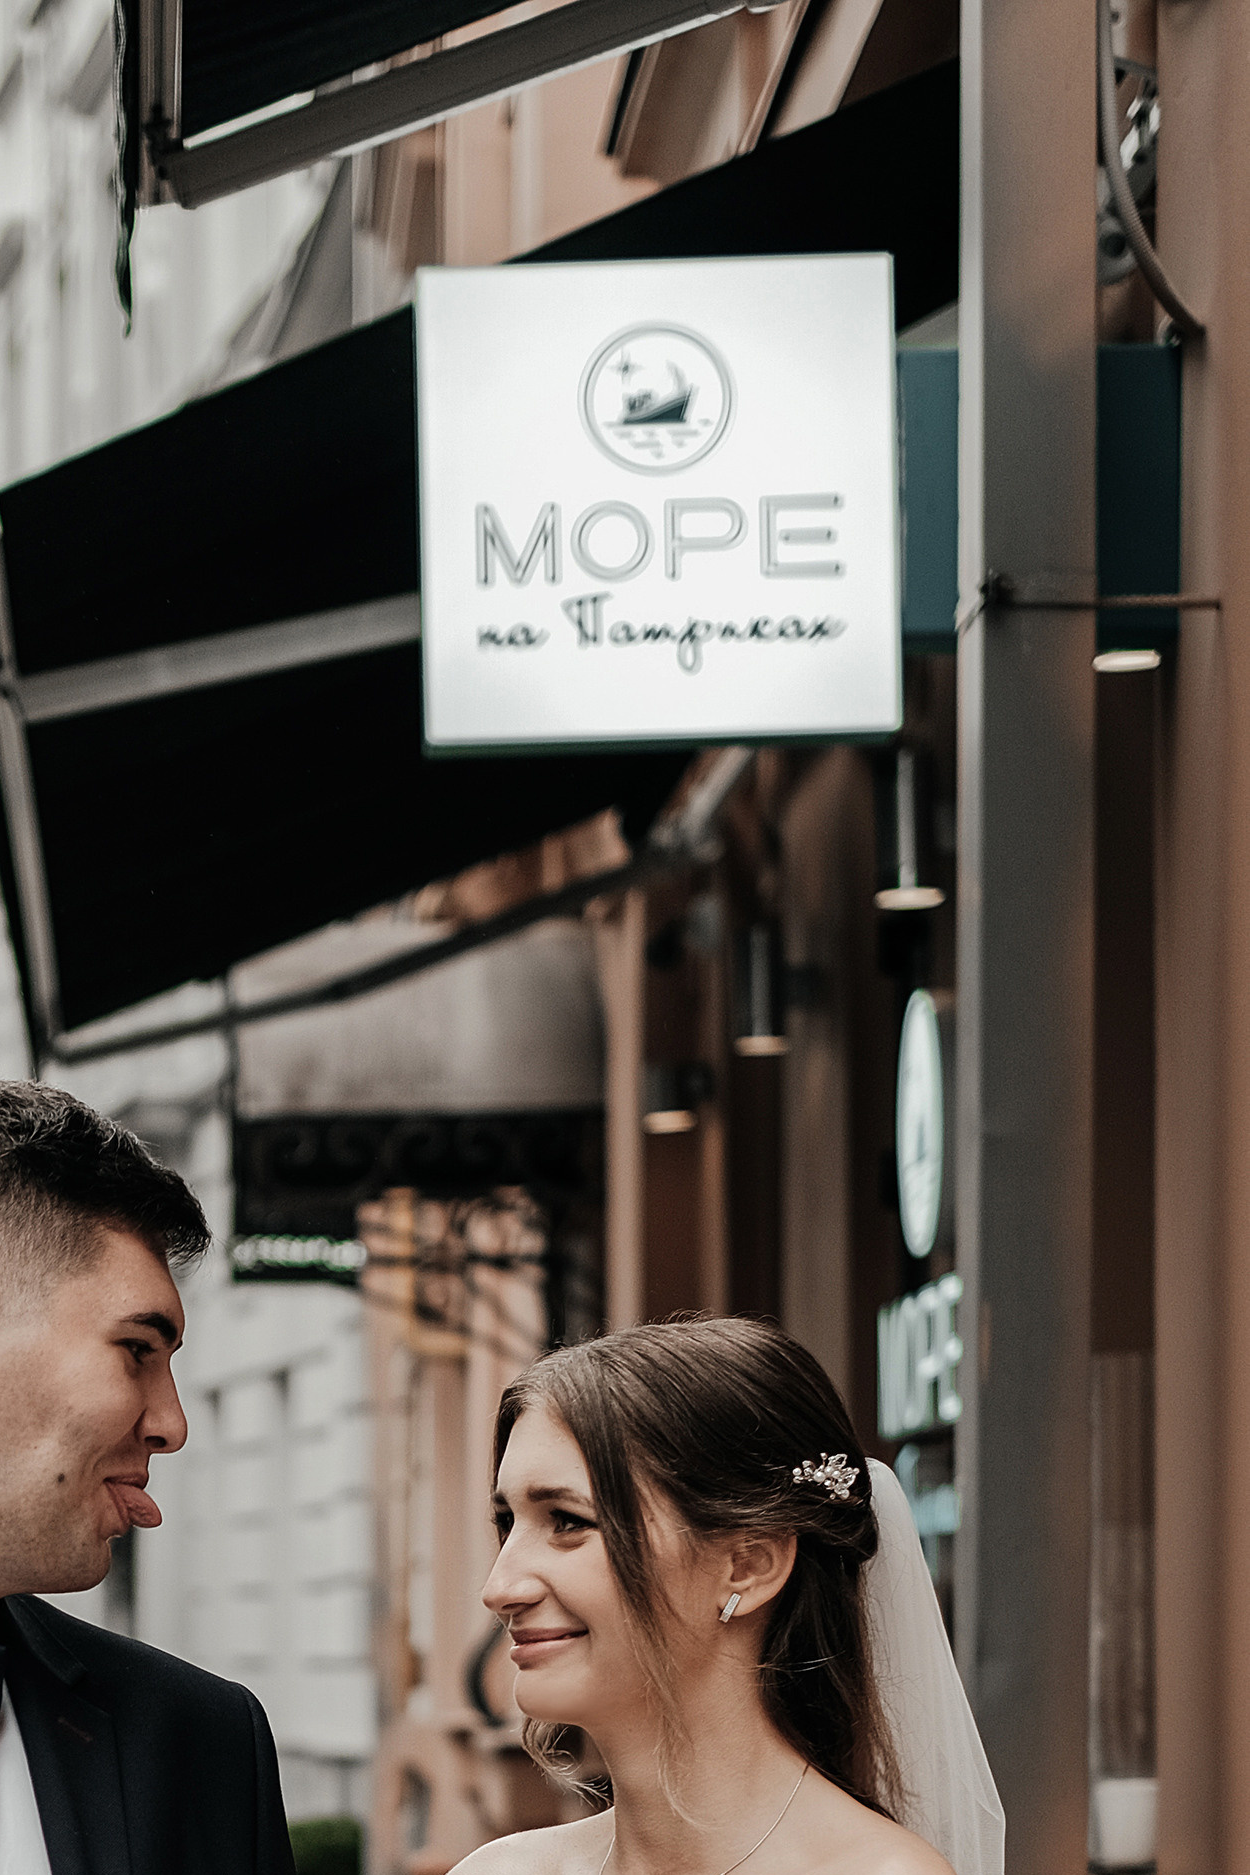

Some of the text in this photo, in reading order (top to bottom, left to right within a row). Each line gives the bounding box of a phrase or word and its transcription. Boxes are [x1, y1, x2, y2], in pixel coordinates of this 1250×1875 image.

[474, 493, 845, 587] МОРЕ
[476, 591, 847, 676] на Патриках
